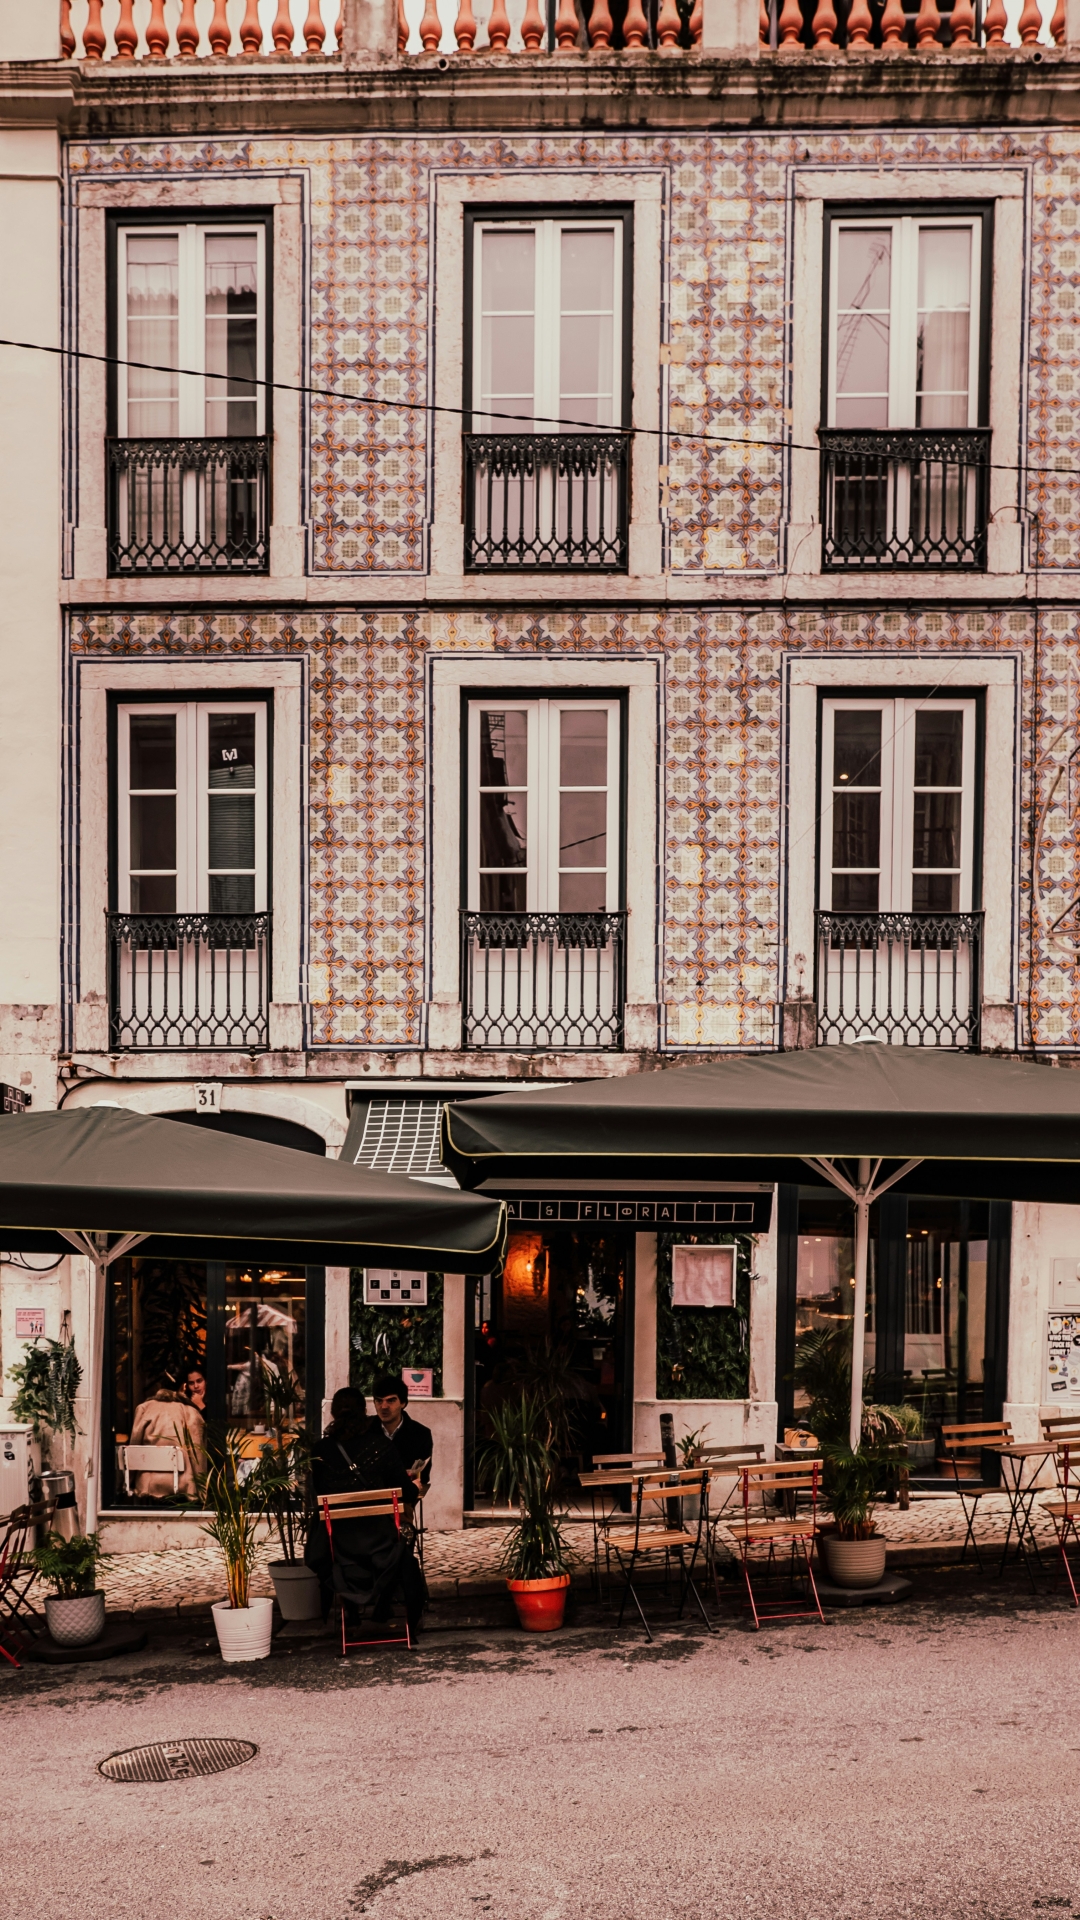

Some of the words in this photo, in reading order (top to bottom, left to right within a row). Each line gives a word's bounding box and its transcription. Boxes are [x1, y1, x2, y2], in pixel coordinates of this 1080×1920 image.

[198, 1089, 216, 1106] 31
[545, 1205, 554, 1216] &
[584, 1205, 670, 1218] FLORA
